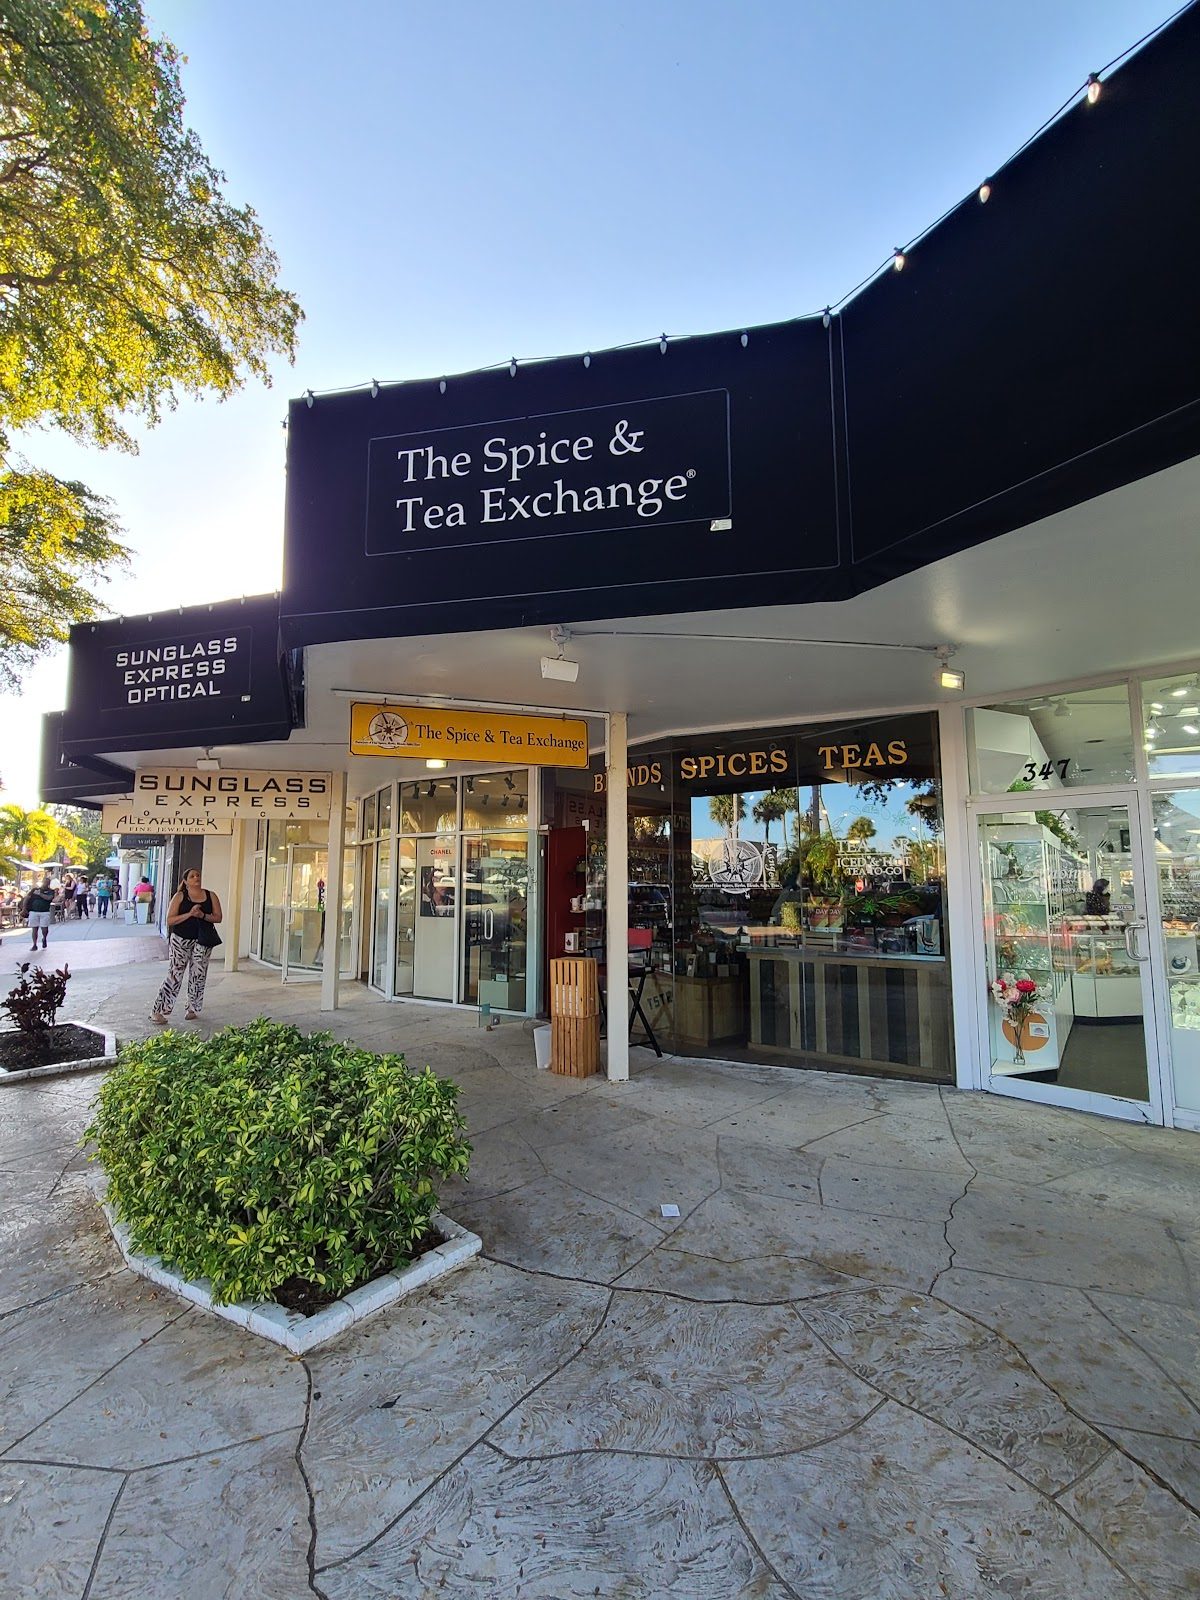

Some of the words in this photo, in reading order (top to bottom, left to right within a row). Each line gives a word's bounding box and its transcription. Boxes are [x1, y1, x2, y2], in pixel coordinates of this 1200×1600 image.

[397, 446, 471, 483] The
[483, 431, 594, 482] Spice
[608, 419, 645, 456] &
[396, 497, 467, 532] Tea
[116, 637, 238, 668] SUNGLASS
[123, 658, 227, 686] EXPRESS
[127, 680, 221, 705] OPTICAL
[415, 724, 442, 740] The
[446, 726, 480, 744] Spice
[484, 730, 496, 744] &
[500, 730, 523, 746] Tea
[527, 731, 585, 752] Exchange
[680, 749, 789, 780] SPICES
[818, 740, 909, 770] TEAS
[139, 774, 327, 794] SUNGLASS
[593, 763, 662, 793] BNDS
[1022, 758, 1072, 783] 347
[143, 810, 322, 819] OPTICAL
[155, 795, 311, 809] EXPRESS
[837, 857, 867, 868] ICED
